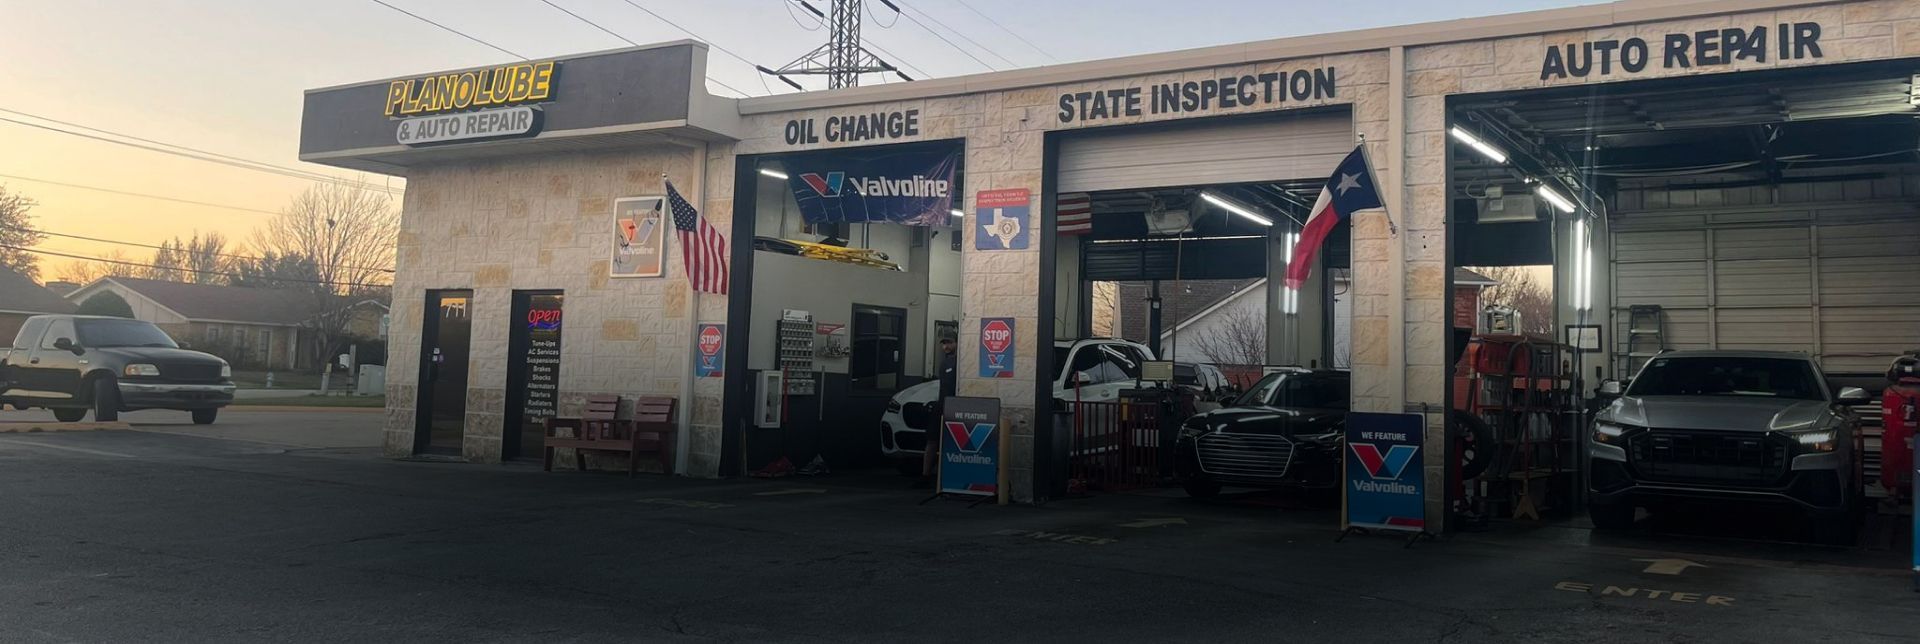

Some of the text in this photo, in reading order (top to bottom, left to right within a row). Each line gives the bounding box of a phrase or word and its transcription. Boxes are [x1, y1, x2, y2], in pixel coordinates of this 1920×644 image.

[1540, 21, 1823, 80] AUTO REPAIR
[1058, 67, 1336, 123] STATE INSPECTION
[398, 110, 529, 141] & AUTO REPAIR
[785, 109, 919, 145] OIL CHANGE
[849, 175, 949, 198] Valvoline
[528, 309, 560, 325] Open
[700, 335, 721, 344] STOP
[985, 330, 1009, 341] STOP
[537, 348, 559, 356] Services
[527, 399, 552, 407] Radiators
[964, 412, 987, 420] FEATURE
[1375, 432, 1407, 441] FEATURE
[946, 453, 992, 465] Valvoline
[1353, 480, 1416, 495] Valvoline
[1554, 581, 1736, 606] ENTER
